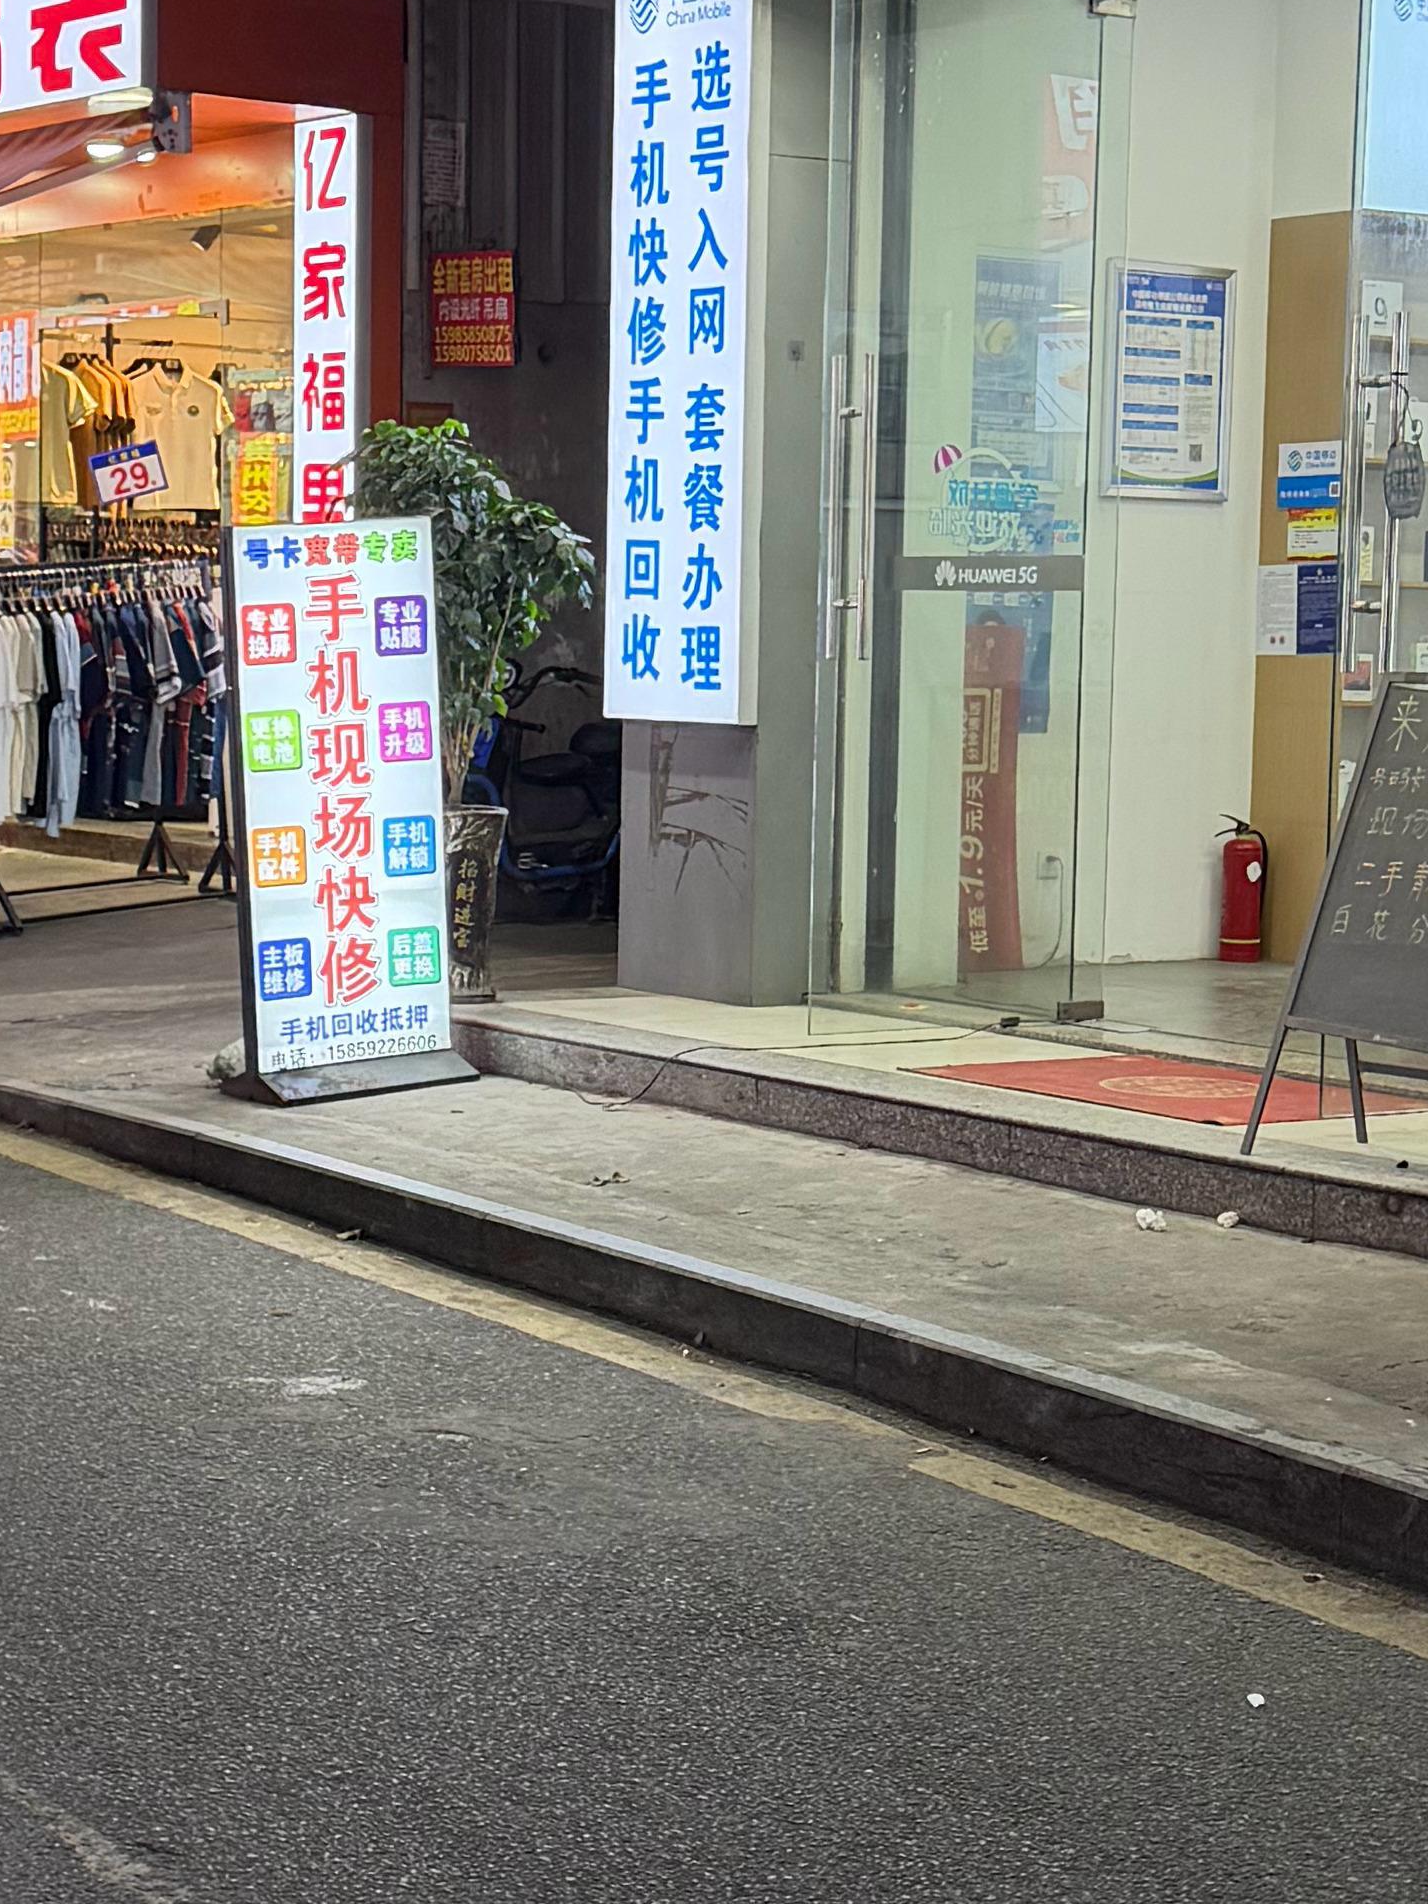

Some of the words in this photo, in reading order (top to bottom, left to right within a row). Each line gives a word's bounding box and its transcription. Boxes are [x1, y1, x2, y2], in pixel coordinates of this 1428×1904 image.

[665, 10, 696, 27] China
[686, 41, 732, 355] 选号入网
[621, 58, 673, 682] 手机快修手机回收
[680, 380, 727, 693] 套餐办理
[242, 530, 419, 570] 号卡宽带专卖
[957, 568, 1016, 584] HUAWEI
[1017, 565, 1039, 585] 5G
[246, 608, 290, 633] 专业
[379, 600, 422, 624] 专业
[250, 715, 294, 739] 更换
[382, 707, 426, 732] 手机
[304, 574, 378, 1005] 手机现场快修
[255, 831, 301, 856] 手机
[386, 822, 429, 846] 手机
[261, 943, 305, 969] 主板
[391, 932, 433, 956] 后盖
[279, 1004, 429, 1045] 手机回收抵押
[327, 1034, 438, 1062] 15859226606
